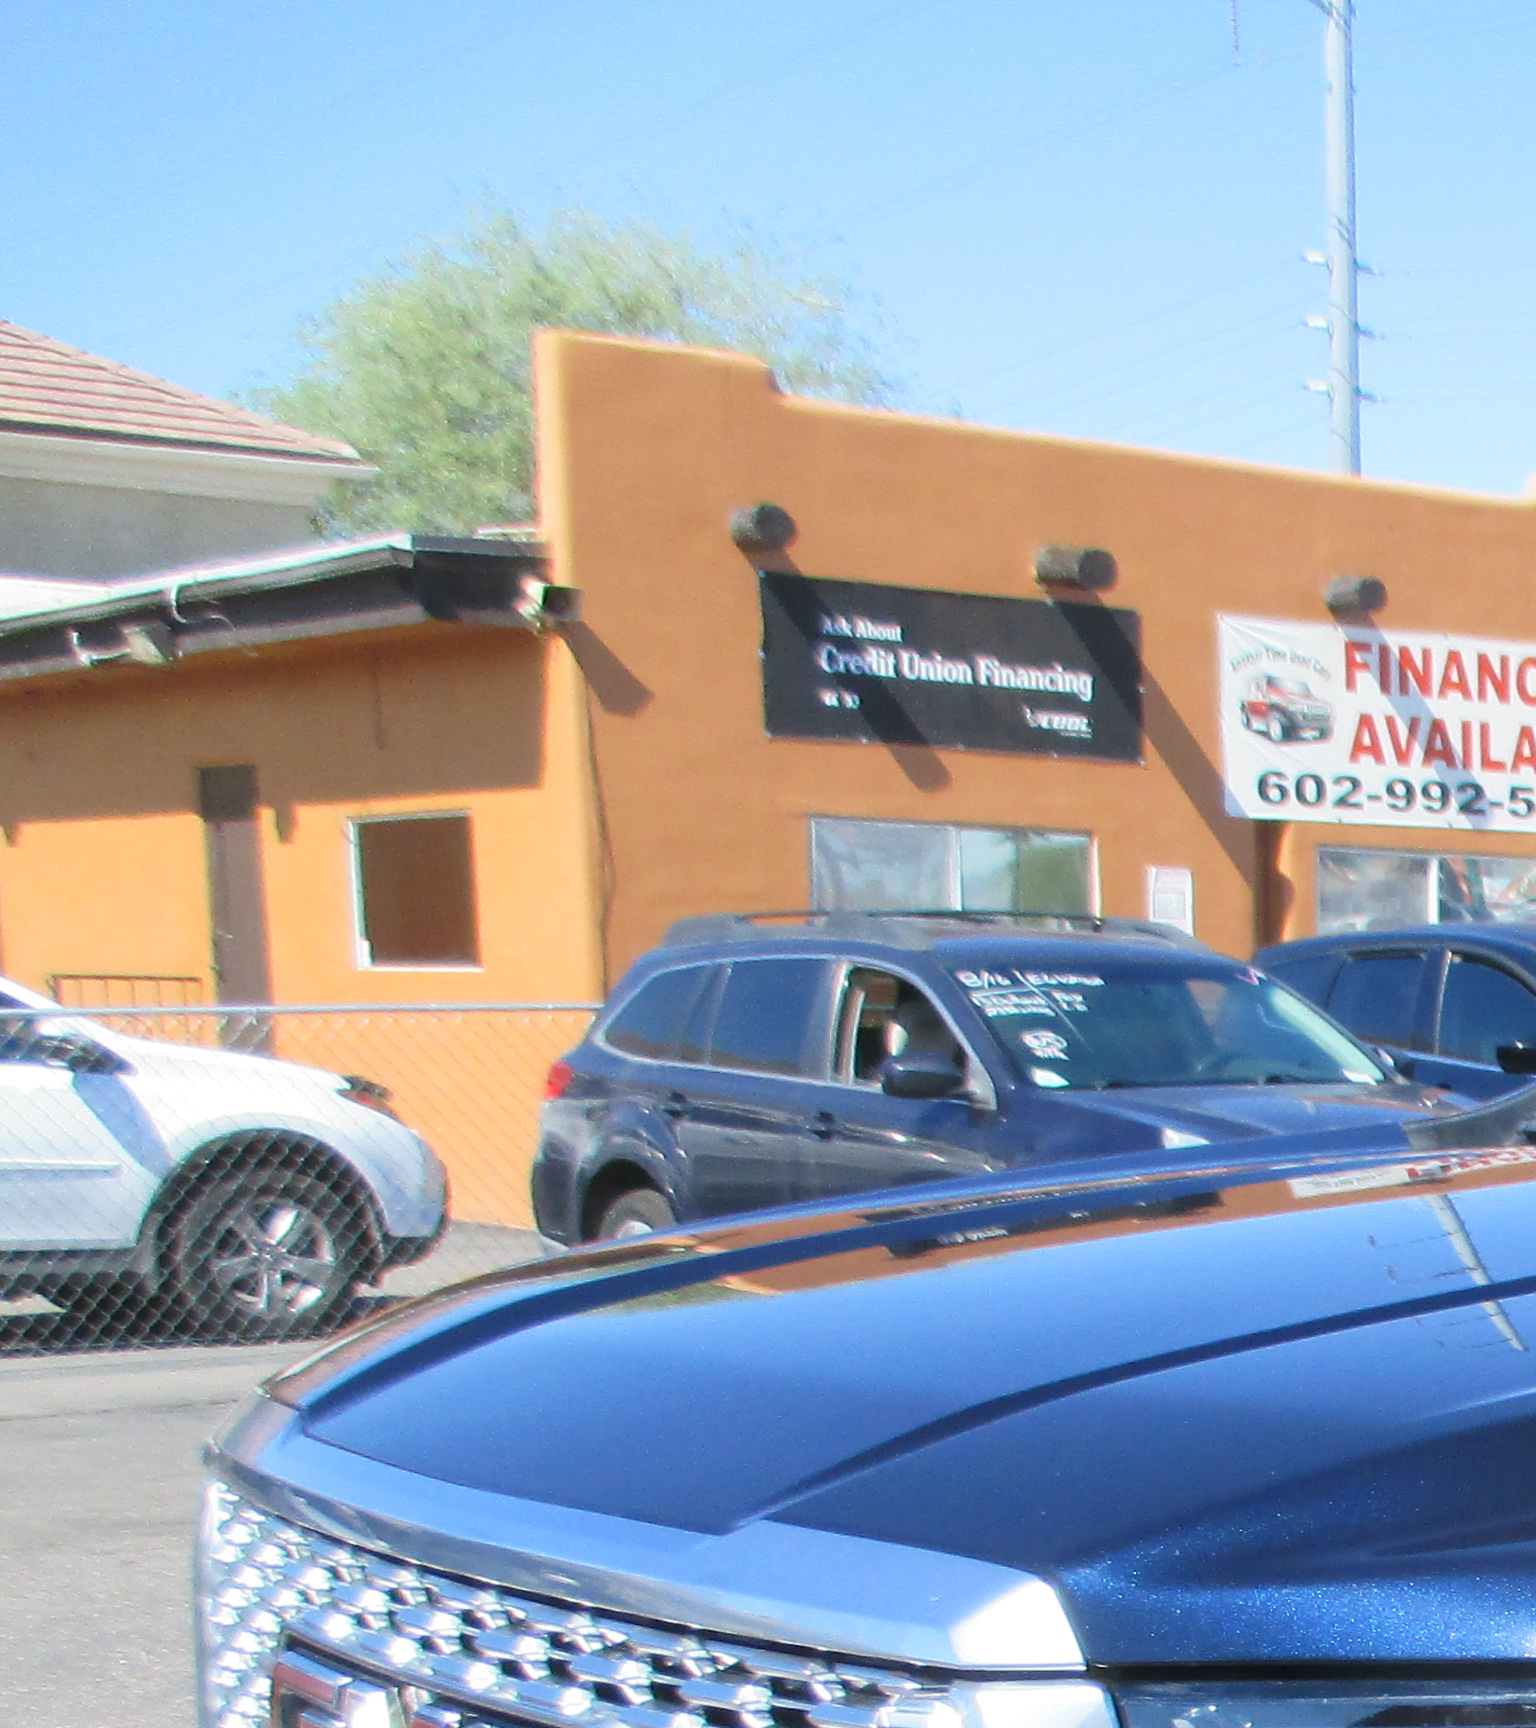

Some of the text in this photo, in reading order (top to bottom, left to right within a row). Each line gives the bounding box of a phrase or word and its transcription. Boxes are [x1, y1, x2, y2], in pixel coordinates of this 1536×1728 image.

[819, 612, 903, 643] Ask About
[814, 642, 1095, 702] Credit Union Financing
